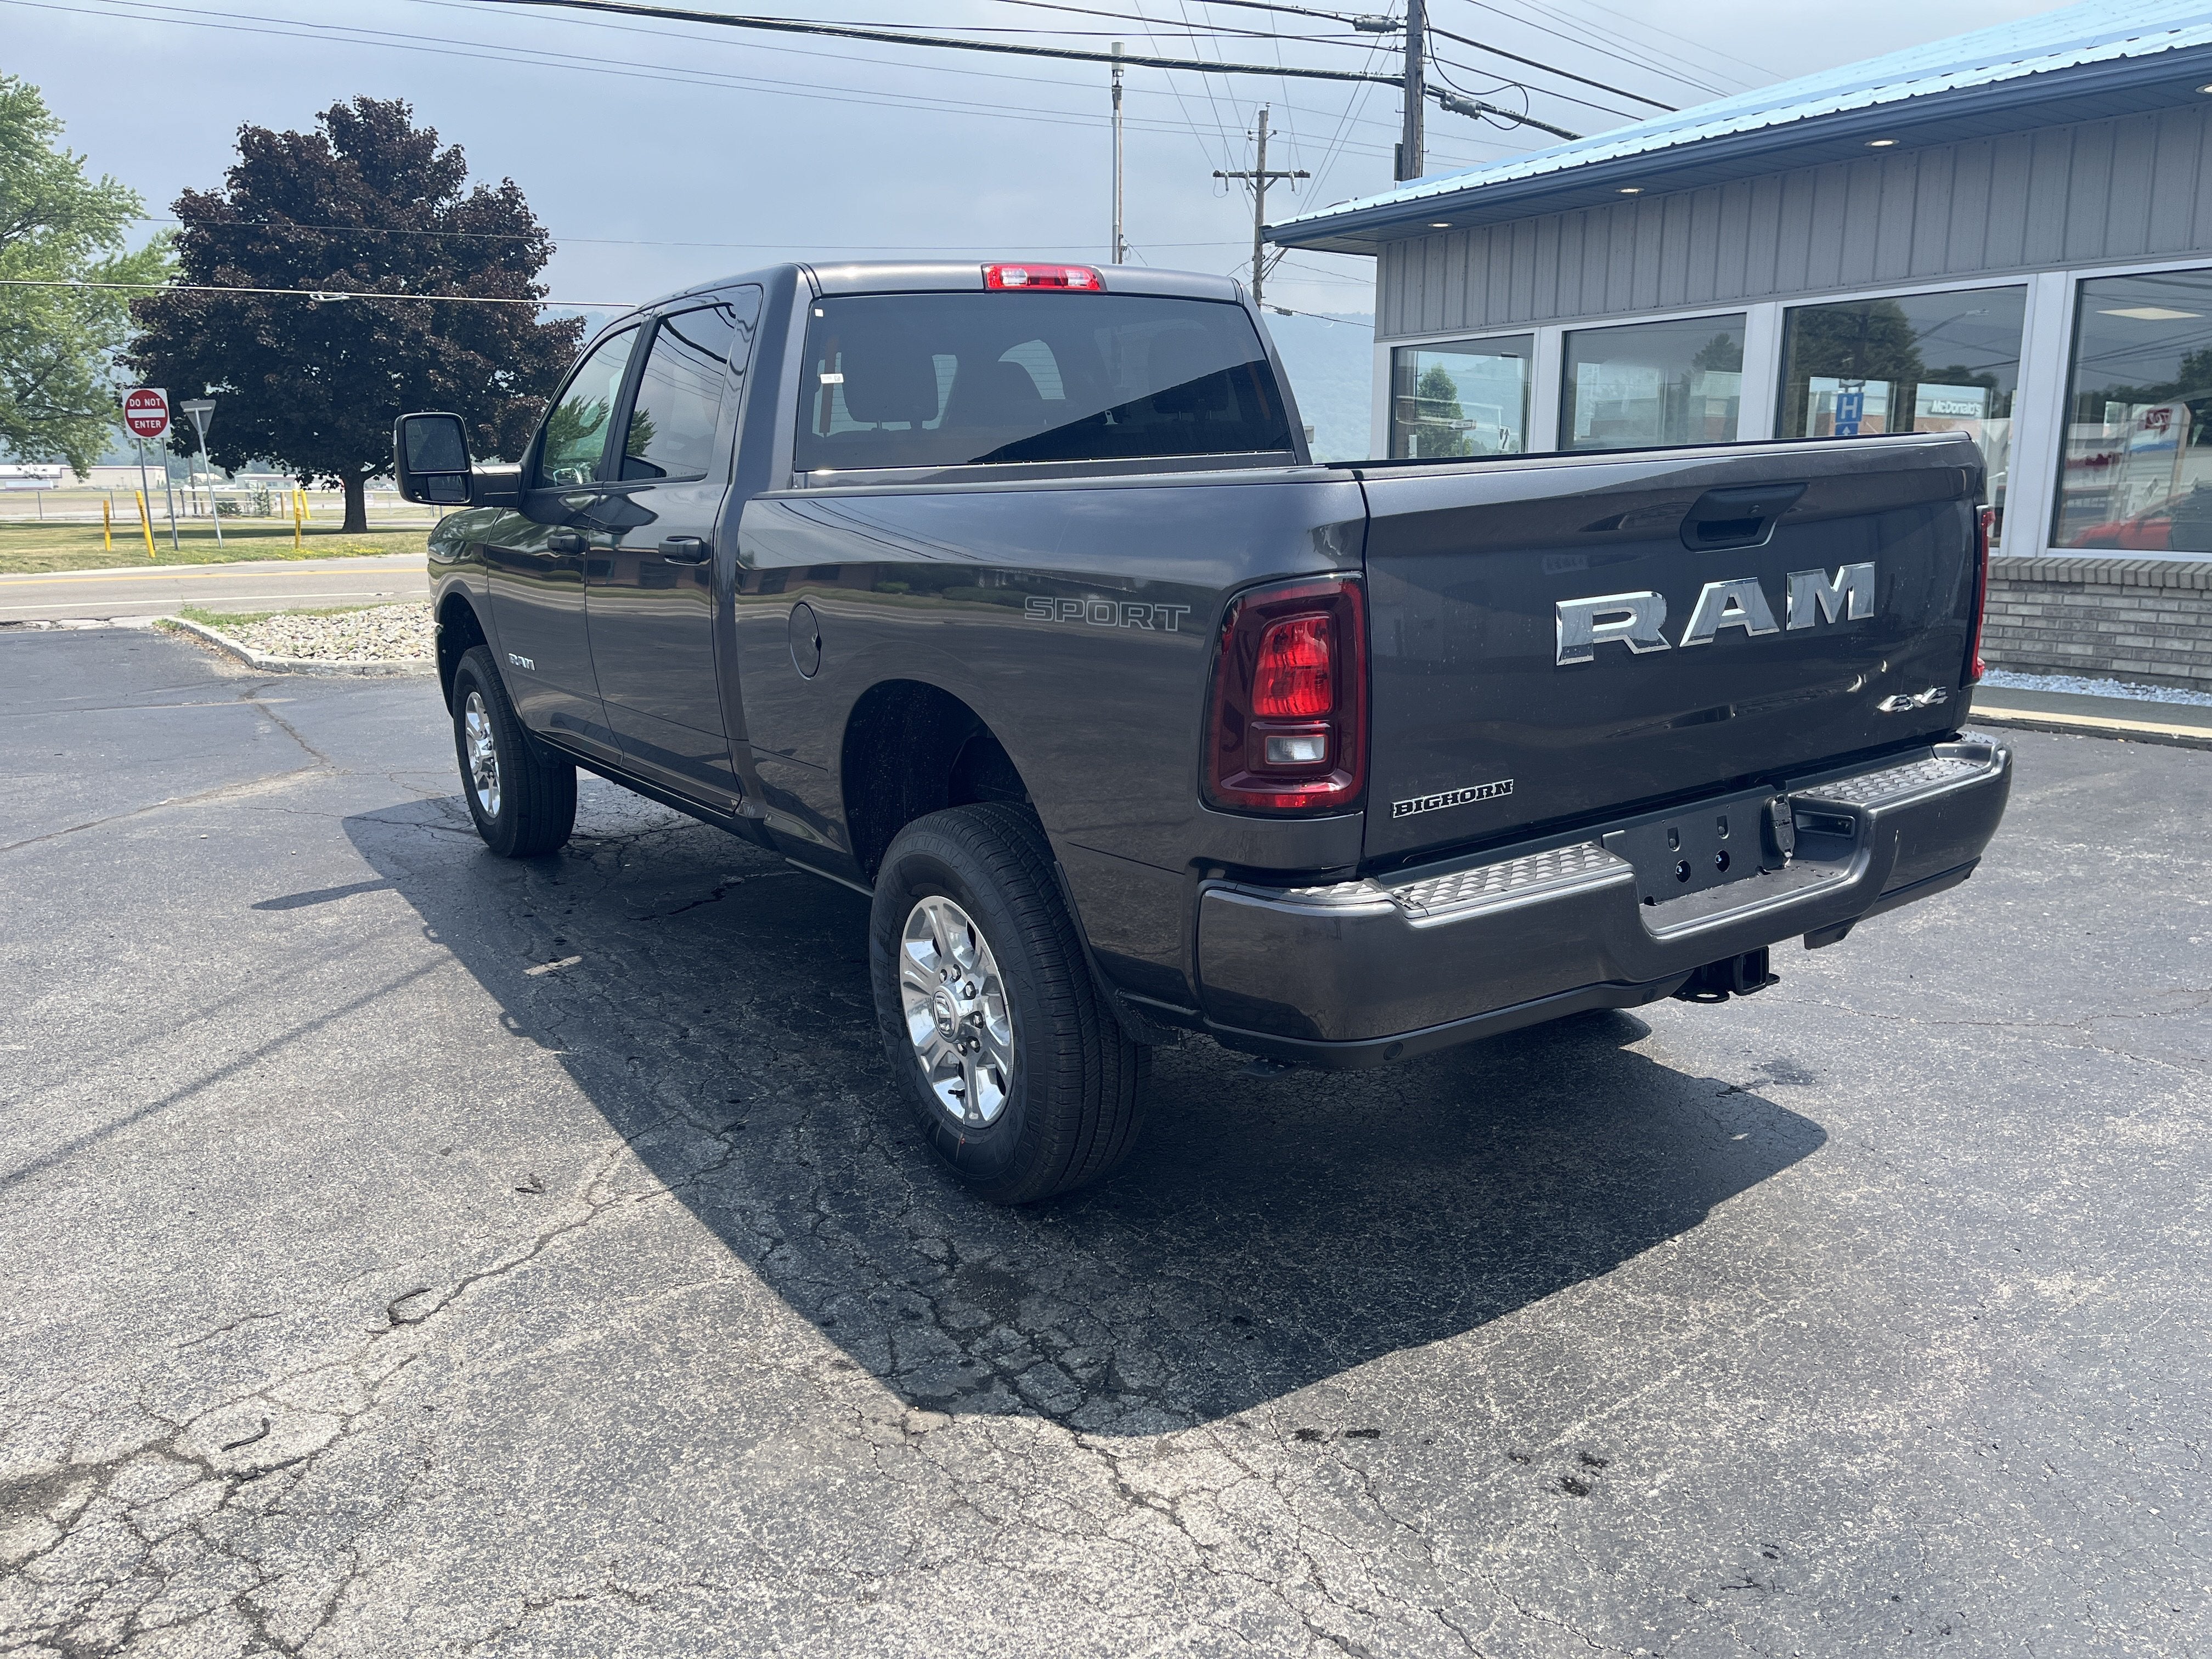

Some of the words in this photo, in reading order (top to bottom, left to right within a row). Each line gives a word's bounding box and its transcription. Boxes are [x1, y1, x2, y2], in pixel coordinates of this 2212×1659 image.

[129, 398, 141, 407] DO
[144, 398, 161, 407] NOT
[1841, 397, 1858, 419] H
[1931, 399, 1983, 415] McDonald's
[134, 420, 161, 428] ENTER
[1024, 596, 1191, 631] SPORT
[1555, 561, 1876, 665] RAM
[508, 653, 536, 671] RAM
[1391, 779, 1514, 818] BIGHORN
